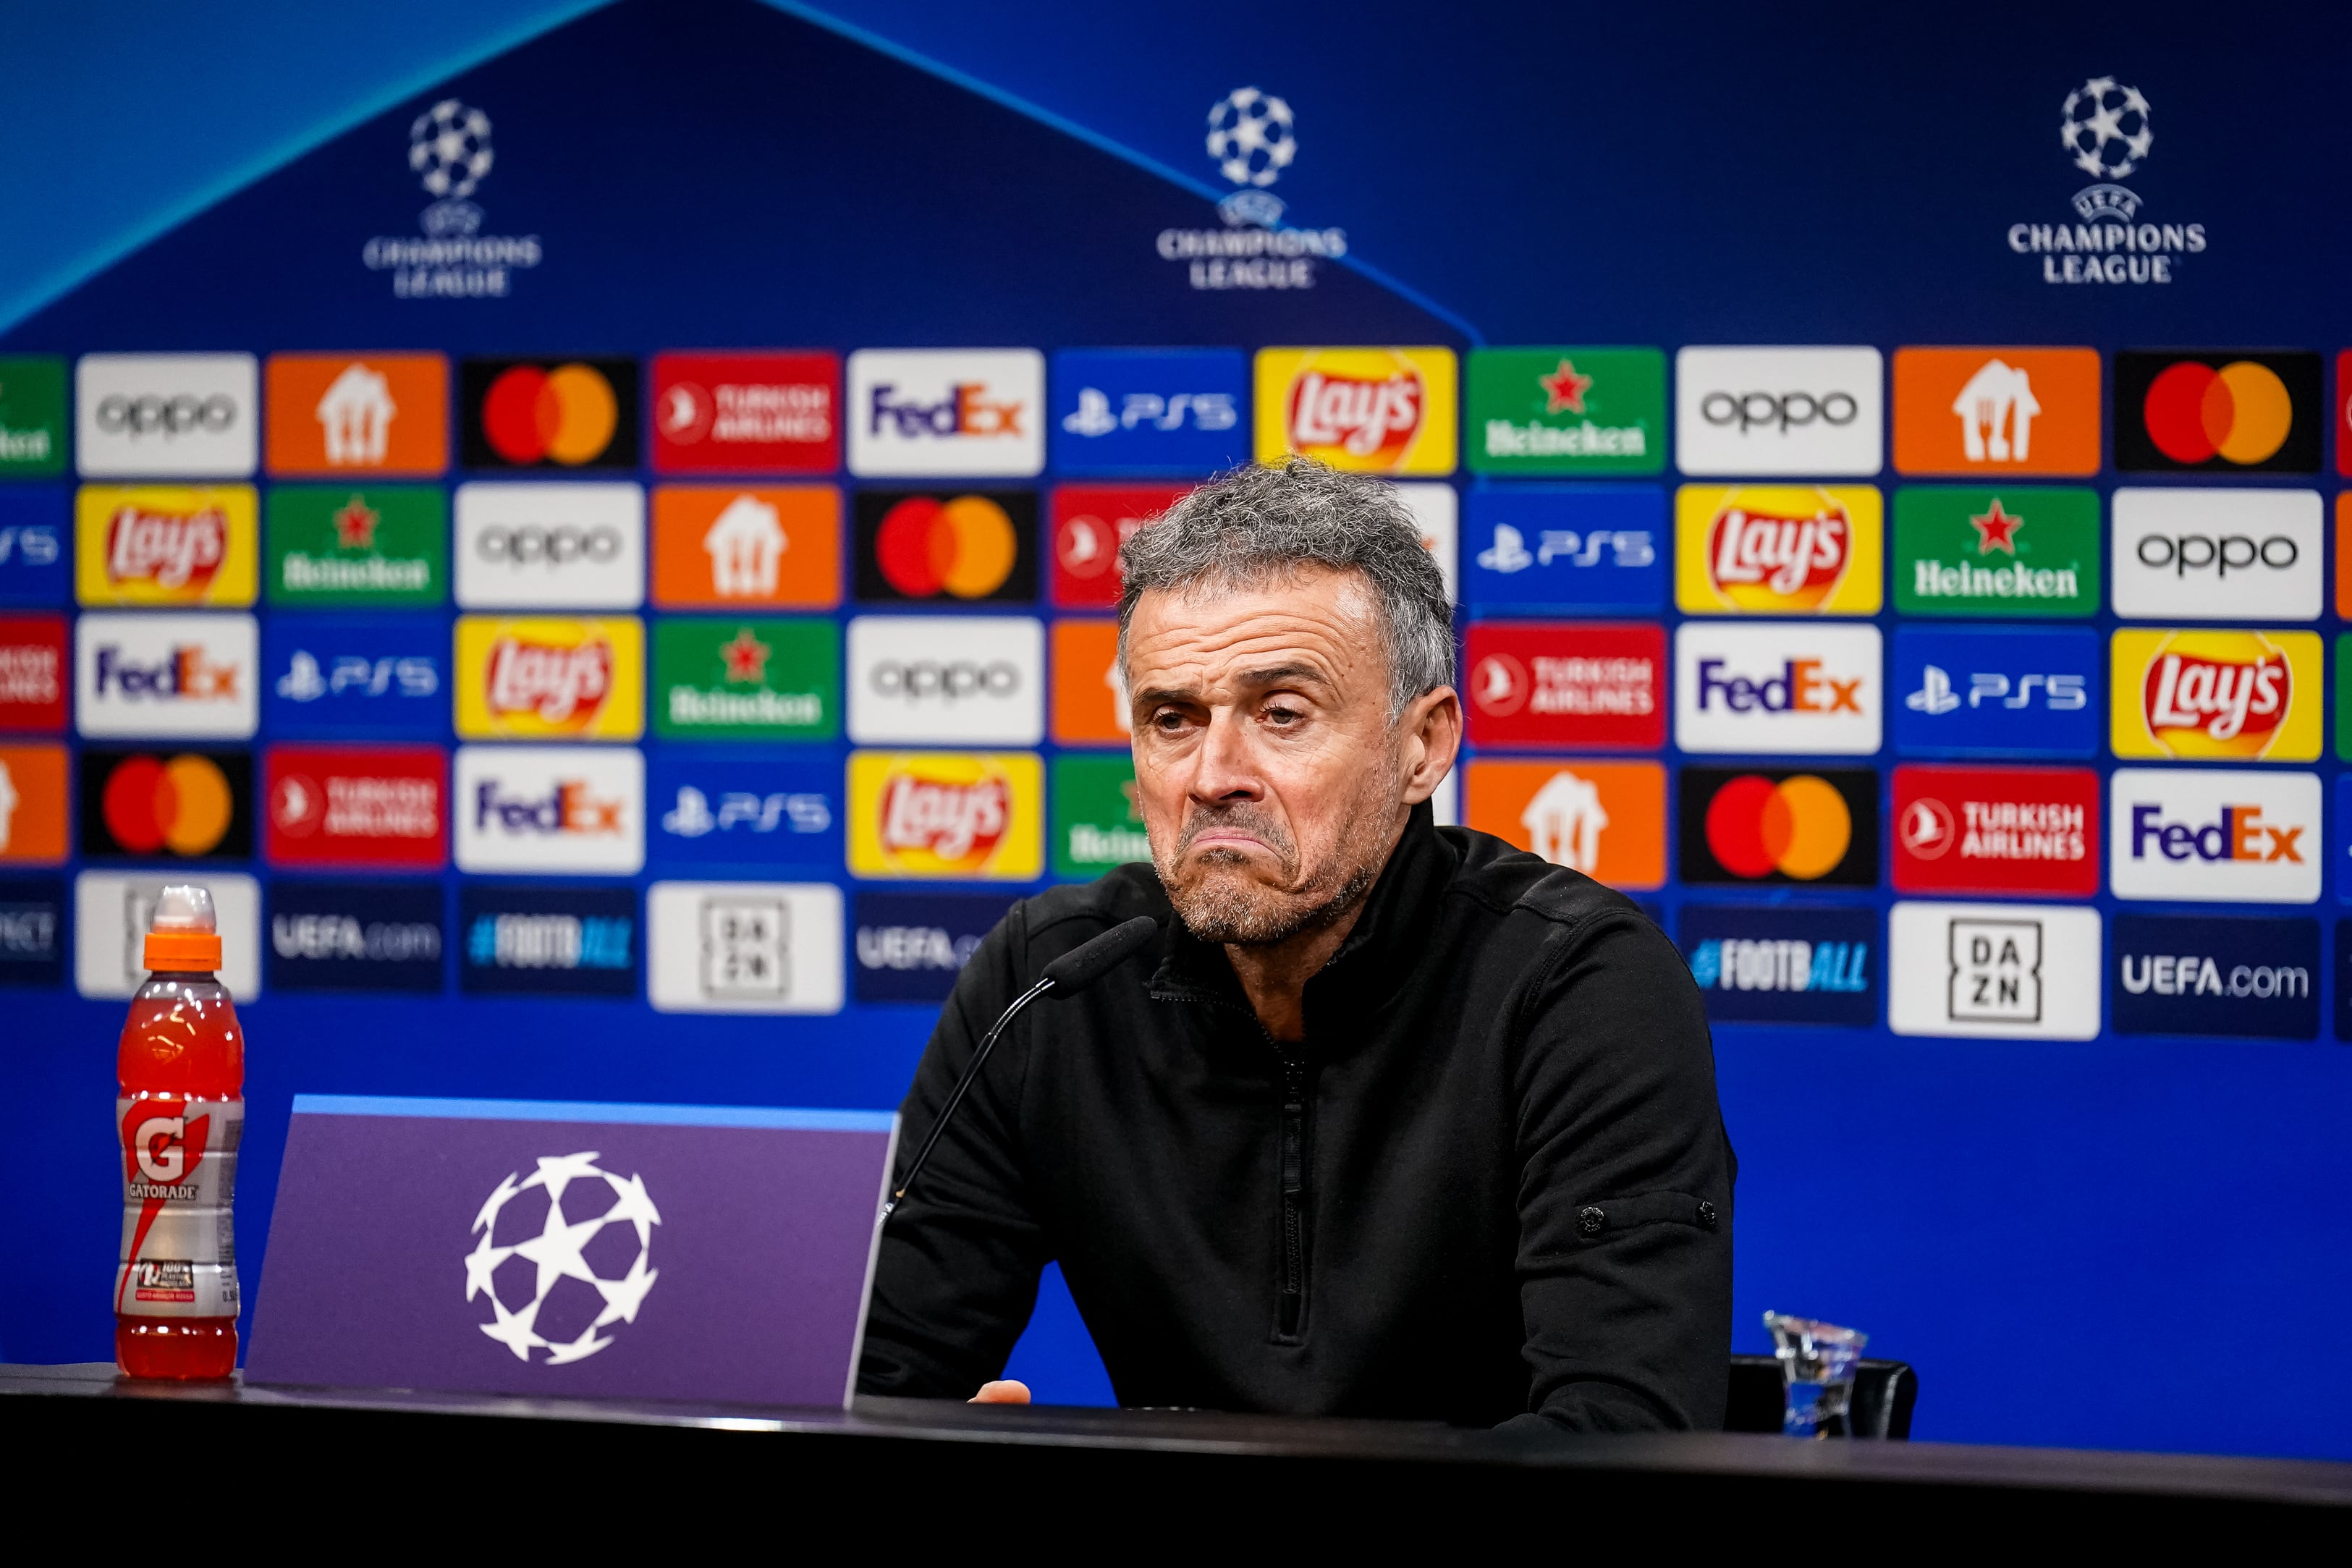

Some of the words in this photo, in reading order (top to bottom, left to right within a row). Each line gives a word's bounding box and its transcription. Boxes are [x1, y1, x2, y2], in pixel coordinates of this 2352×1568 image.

[2074, 188, 2137, 219] UEFA
[363, 234, 543, 269] CHAMPIONS
[1156, 228, 1347, 260] CHAMPIONS
[2008, 223, 2207, 253] CHAMPIONS
[1190, 258, 1316, 289] LEAGUE
[2044, 255, 2171, 284] LEAGUE
[96, 394, 239, 441] oppo
[871, 383, 1025, 437] FedEx
[1122, 393, 1238, 431] PS5
[1295, 370, 1419, 455] Lay's
[1701, 390, 1858, 436] oppo
[1486, 420, 1646, 457] Heineken
[475, 524, 624, 569] oppo
[1537, 530, 1656, 567] PS5
[1716, 509, 1845, 594] Lay's
[2138, 533, 2298, 580] oppo
[1914, 559, 2078, 598] Heineken
[96, 646, 240, 703] FedEx
[330, 656, 439, 697] PS5
[492, 640, 606, 722] Lay's
[871, 661, 1022, 707] oppo
[1530, 656, 1653, 683] TURKISH
[1698, 658, 1864, 715] FedEx
[1969, 674, 2086, 710] PS5
[1529, 686, 1654, 715] AIRLINES
[2152, 654, 2283, 739] Lay's
[475, 779, 622, 835] FedEx
[718, 792, 831, 833] PS5
[886, 778, 1003, 859] Lay's
[1961, 802, 2084, 829] TURKISH
[1960, 832, 2085, 860] AIRLINES
[2132, 804, 2306, 864] FedEx
[273, 914, 441, 961] UEFA.com
[1691, 938, 1868, 992] #FOOTBALL
[2122, 954, 2309, 999] UEFA.com
[135, 1116, 184, 1182] G
[130, 1184, 195, 1200] GATORADE
